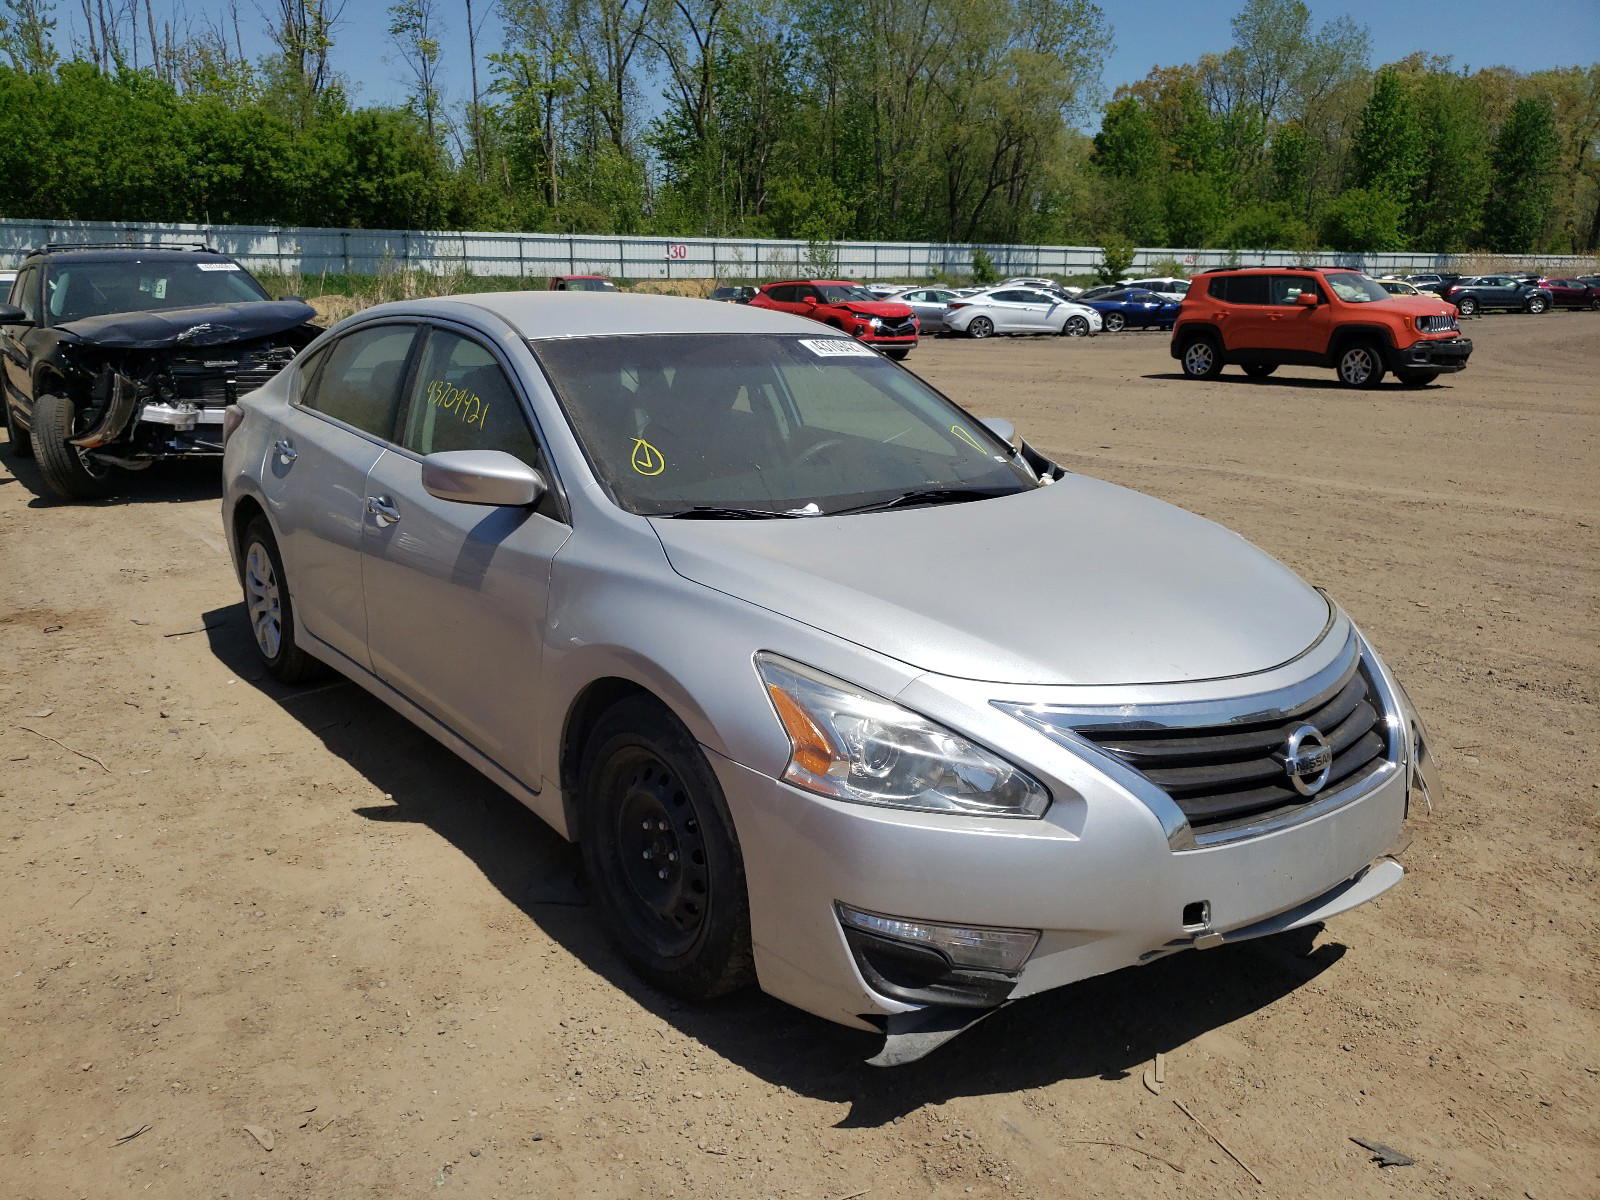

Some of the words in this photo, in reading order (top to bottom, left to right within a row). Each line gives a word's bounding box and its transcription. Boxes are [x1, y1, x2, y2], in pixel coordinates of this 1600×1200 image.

[670, 245, 687, 259] 30
[427, 379, 490, 430] 43709421
[1295, 751, 1330, 772] NSSAN
